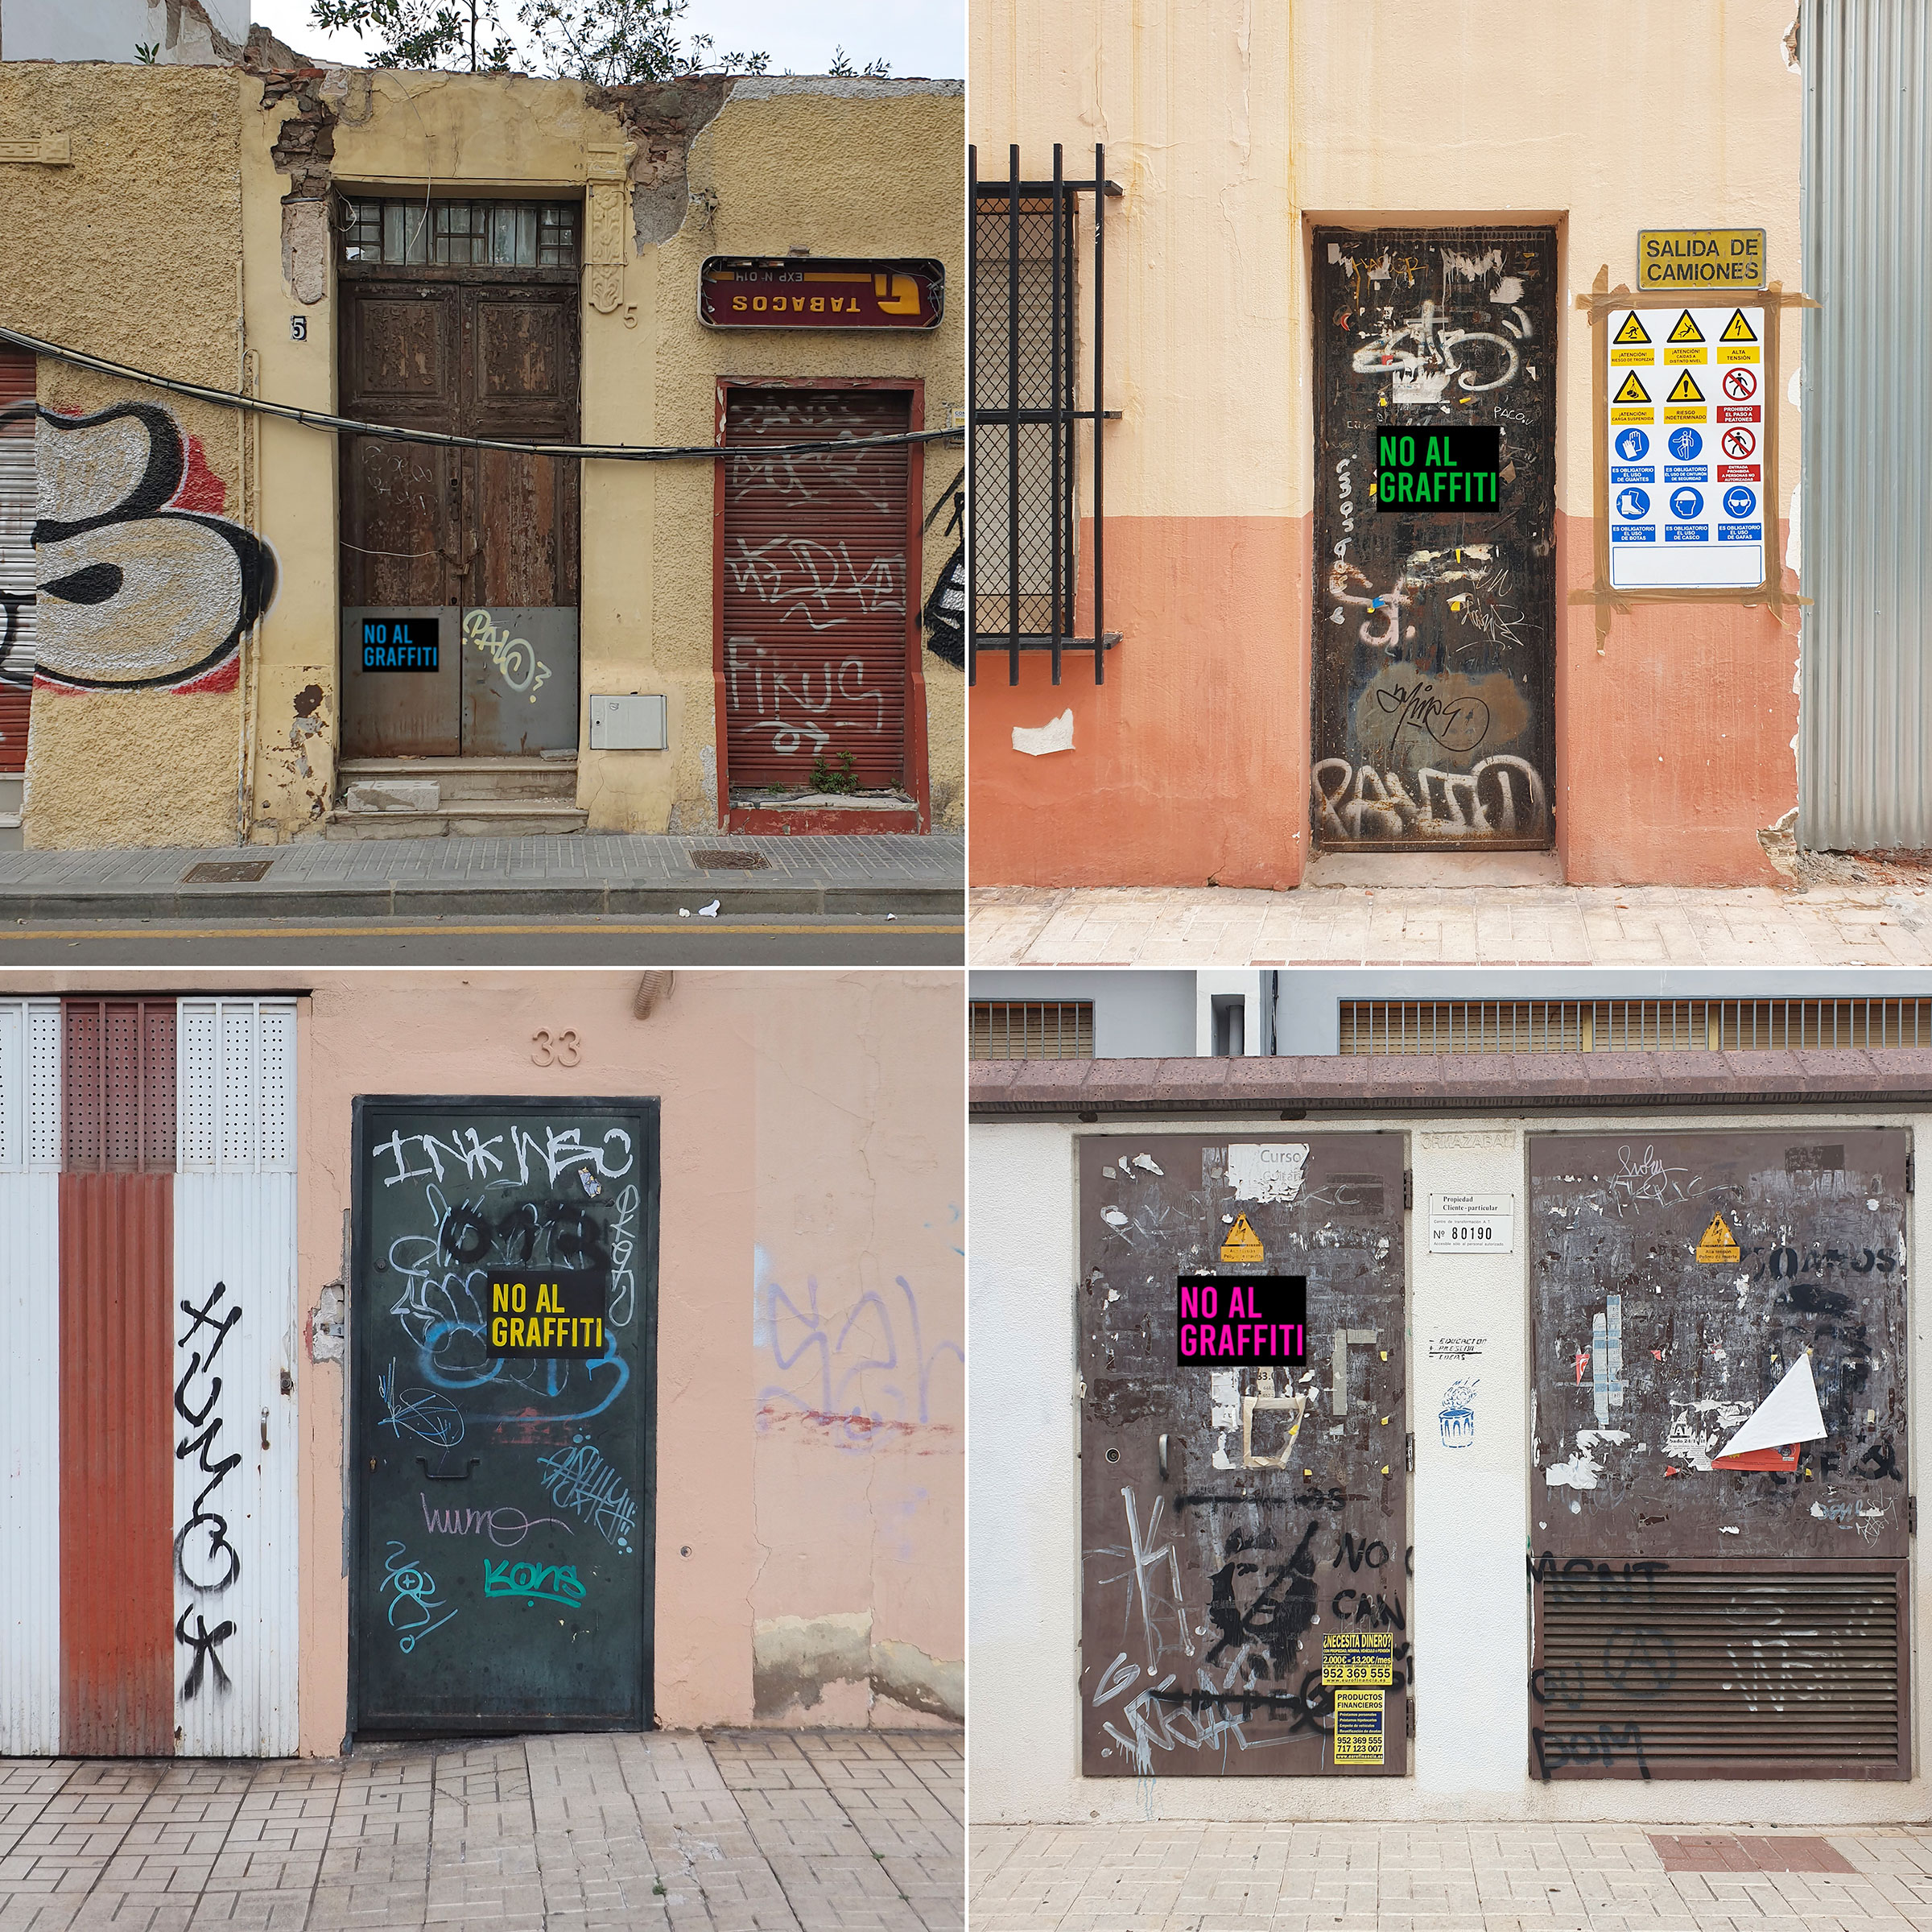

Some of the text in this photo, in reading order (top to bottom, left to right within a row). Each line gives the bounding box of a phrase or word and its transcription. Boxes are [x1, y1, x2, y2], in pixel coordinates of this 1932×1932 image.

[1646, 238, 1758, 258] SALIDA DE
[1647, 262, 1759, 282] CAMIONES
[732, 295, 861, 313] TABACOS
[624, 303, 638, 329] 5
[293, 318, 305, 339] 5
[1380, 436, 1457, 467] NO AL
[1380, 472, 1496, 503] GRAFFITI
[365, 624, 413, 645] NO AL
[365, 646, 438, 667] GRAFFITI
[530, 1026, 582, 1067] 33
[1260, 1149, 1302, 1163] Curso
[1443, 1195, 1474, 1203] Propiedad
[1433, 1226, 1492, 1241] Nº 80190
[492, 1282, 565, 1314] NO AL
[1180, 1286, 1262, 1319] NO AL
[491, 1316, 602, 1348] GRAFFITI
[1180, 1323, 1304, 1357] GRAFFITI
[1323, 1634, 1392, 1649] ¿NECESITA DINERO?
[1323, 1668, 1391, 1678] 952 369 555
[1337, 1736, 1383, 1744] 952 369 555
[1337, 1744, 1383, 1752] 717 123 007
